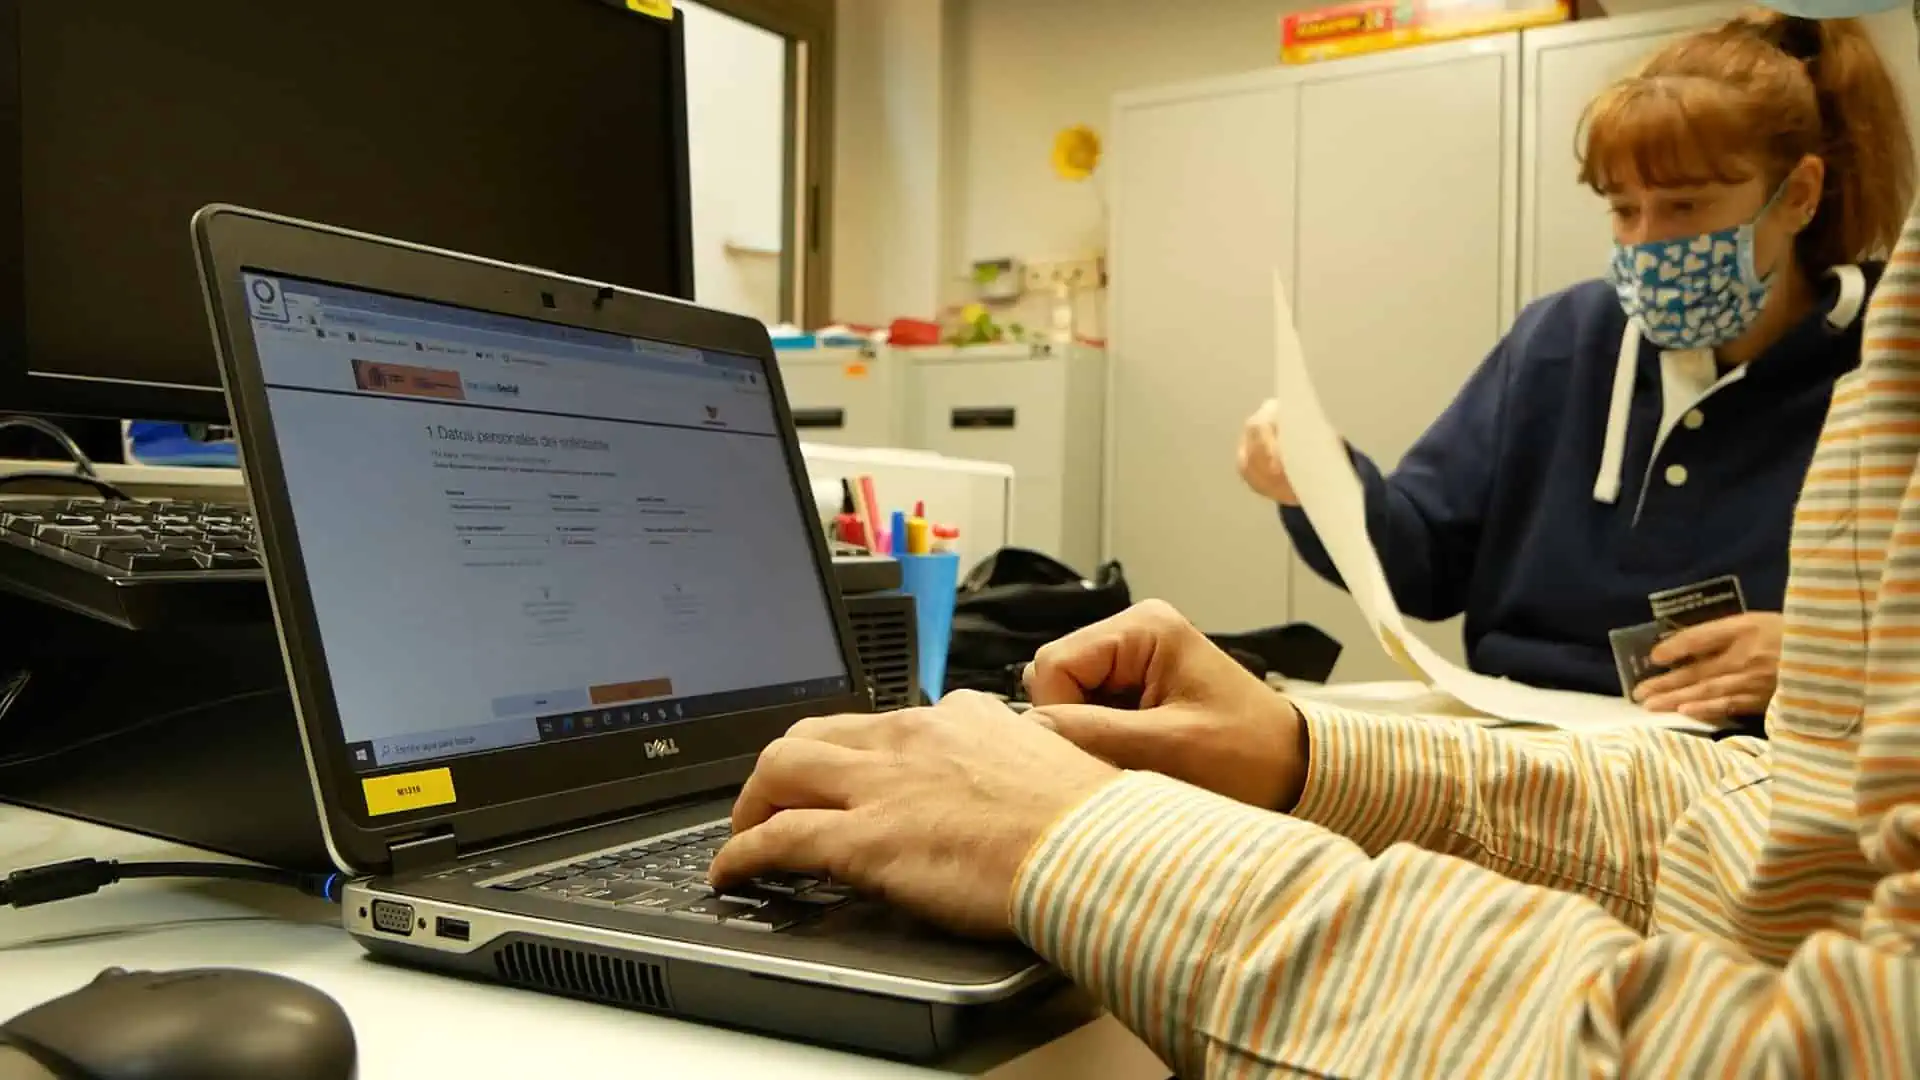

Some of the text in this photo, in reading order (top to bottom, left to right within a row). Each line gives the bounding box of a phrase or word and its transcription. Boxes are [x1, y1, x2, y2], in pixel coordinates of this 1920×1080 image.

[425, 424, 433, 439] 1
[437, 424, 474, 443] Datos
[477, 430, 539, 447] personales
[643, 737, 680, 759] DELL
